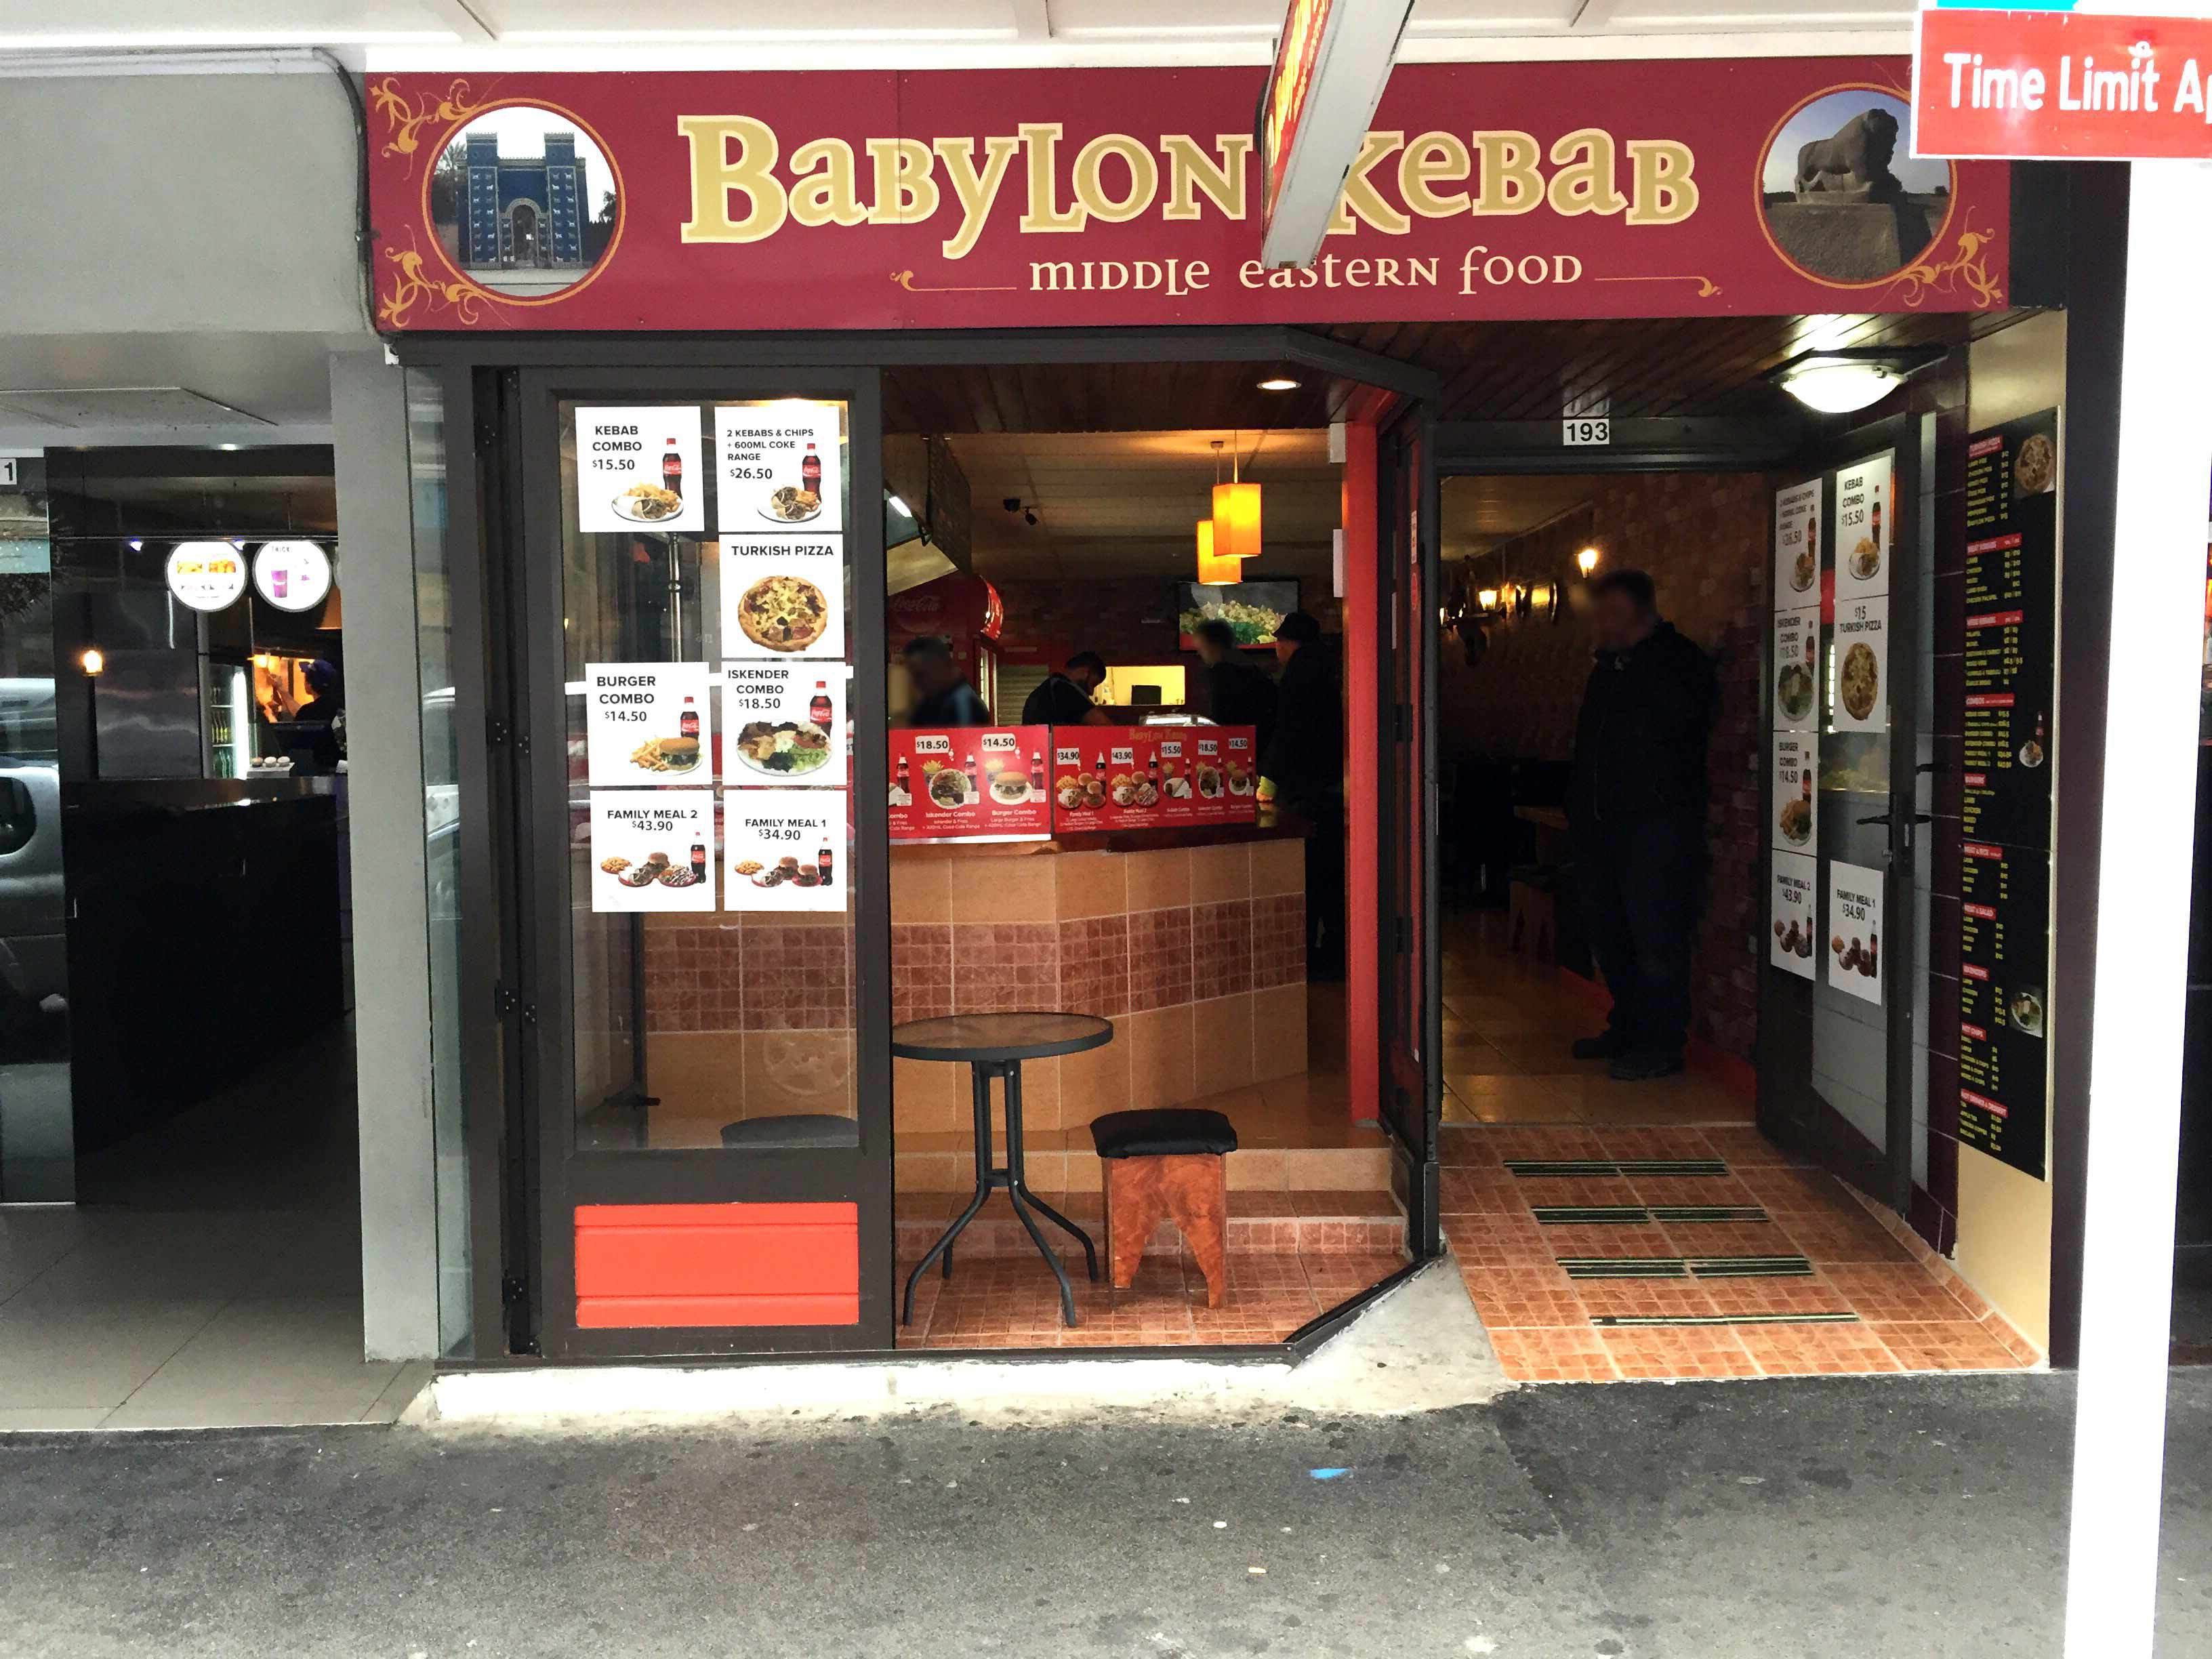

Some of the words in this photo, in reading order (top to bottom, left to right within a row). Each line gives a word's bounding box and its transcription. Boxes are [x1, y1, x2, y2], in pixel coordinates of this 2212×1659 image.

[1944, 52, 2045, 110] Time
[2059, 54, 2159, 112] Limit
[594, 425, 639, 436] KEBAB
[726, 429, 733, 437] 2
[735, 429, 774, 437] KEBABS
[776, 429, 783, 437] &
[784, 428, 814, 437] CHIPS
[1566, 422, 1608, 442] 193
[592, 441, 642, 451] COMBO
[734, 441, 767, 449] 600ML
[769, 441, 796, 449] COKE
[727, 453, 761, 462] RANGE
[592, 459, 635, 470] $15.50
[729, 468, 773, 480] $26.50
[1844, 476, 1864, 491] KEBAB
[1843, 493, 1864, 508] COMBO
[1841, 509, 1864, 527] $15.50
[731, 546, 792, 556] TURKISH
[795, 545, 834, 556] PIZZA
[1839, 621, 1864, 634] TURKISH
[1864, 619, 1882, 631] PIZZA
[727, 670, 790, 679] ISKENDER
[596, 676, 656, 687] BURGER
[736, 684, 784, 695] COMBO
[599, 693, 655, 704] COMBO
[739, 698, 781, 710] $18.50
[605, 710, 647, 722] $14.50
[916, 740, 949, 750] $18.50
[983, 738, 1015, 747] $14.50
[1057, 751, 1080, 760] $34.90
[1112, 751, 1132, 760] $43.90
[607, 810, 651, 820] FAMILY
[653, 810, 687, 819] MEAL
[690, 810, 698, 819] 2
[632, 820, 673, 832] $43.90
[745, 819, 784, 828] FAMILY
[787, 819, 818, 827] MEAL
[821, 819, 826, 827] 1
[758, 829, 802, 841] $34.90
[1837, 888, 1856, 903] FAMILY
[1856, 893, 1872, 907] MEAL
[1842, 903, 1866, 921] $34.90
